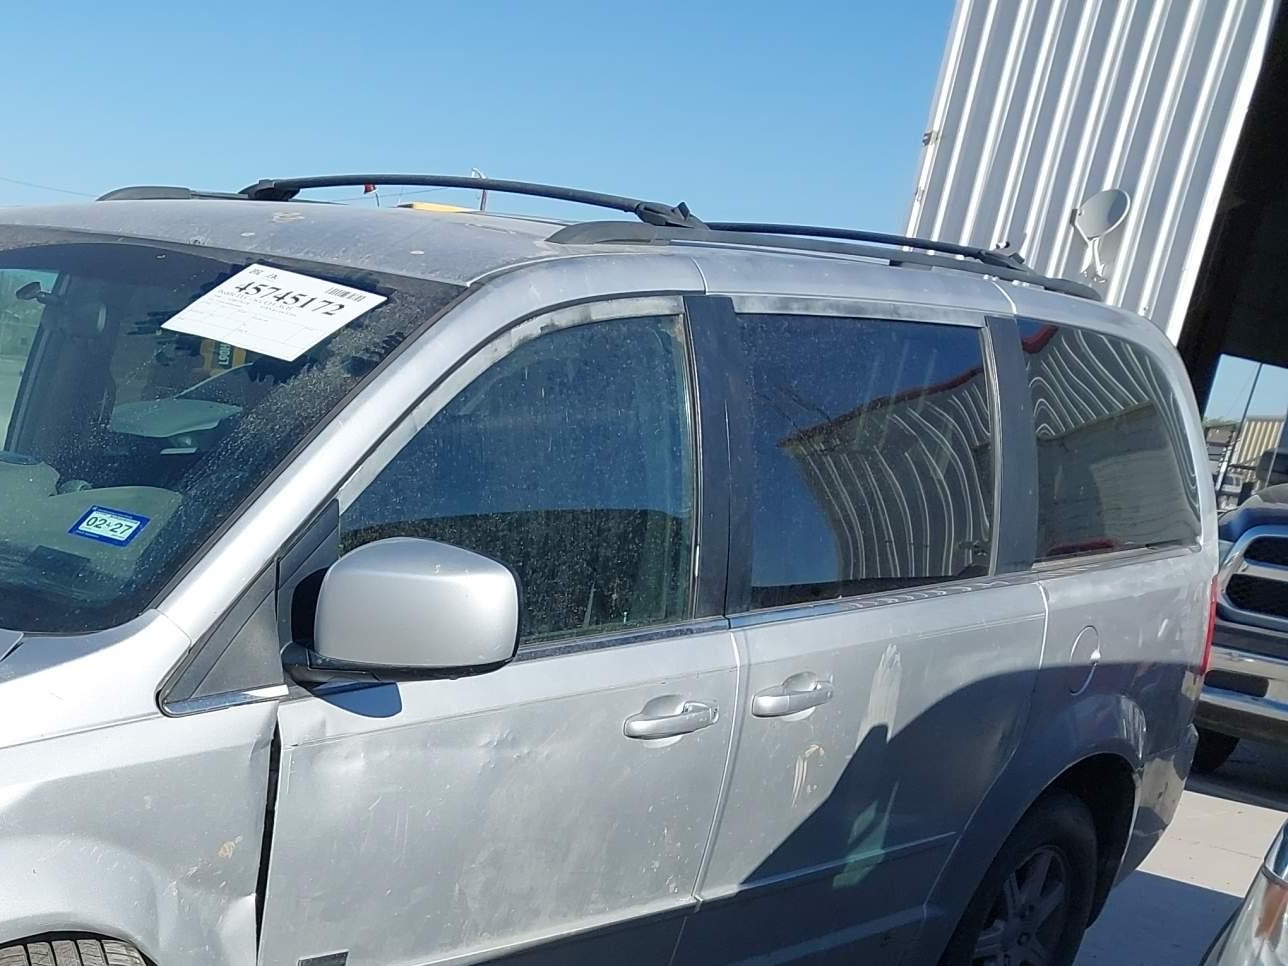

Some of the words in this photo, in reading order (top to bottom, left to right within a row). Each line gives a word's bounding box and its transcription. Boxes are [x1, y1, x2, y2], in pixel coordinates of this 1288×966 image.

[234, 280, 345, 316] 45745172
[85, 516, 108, 529] 02
[109, 521, 133, 535] 27
